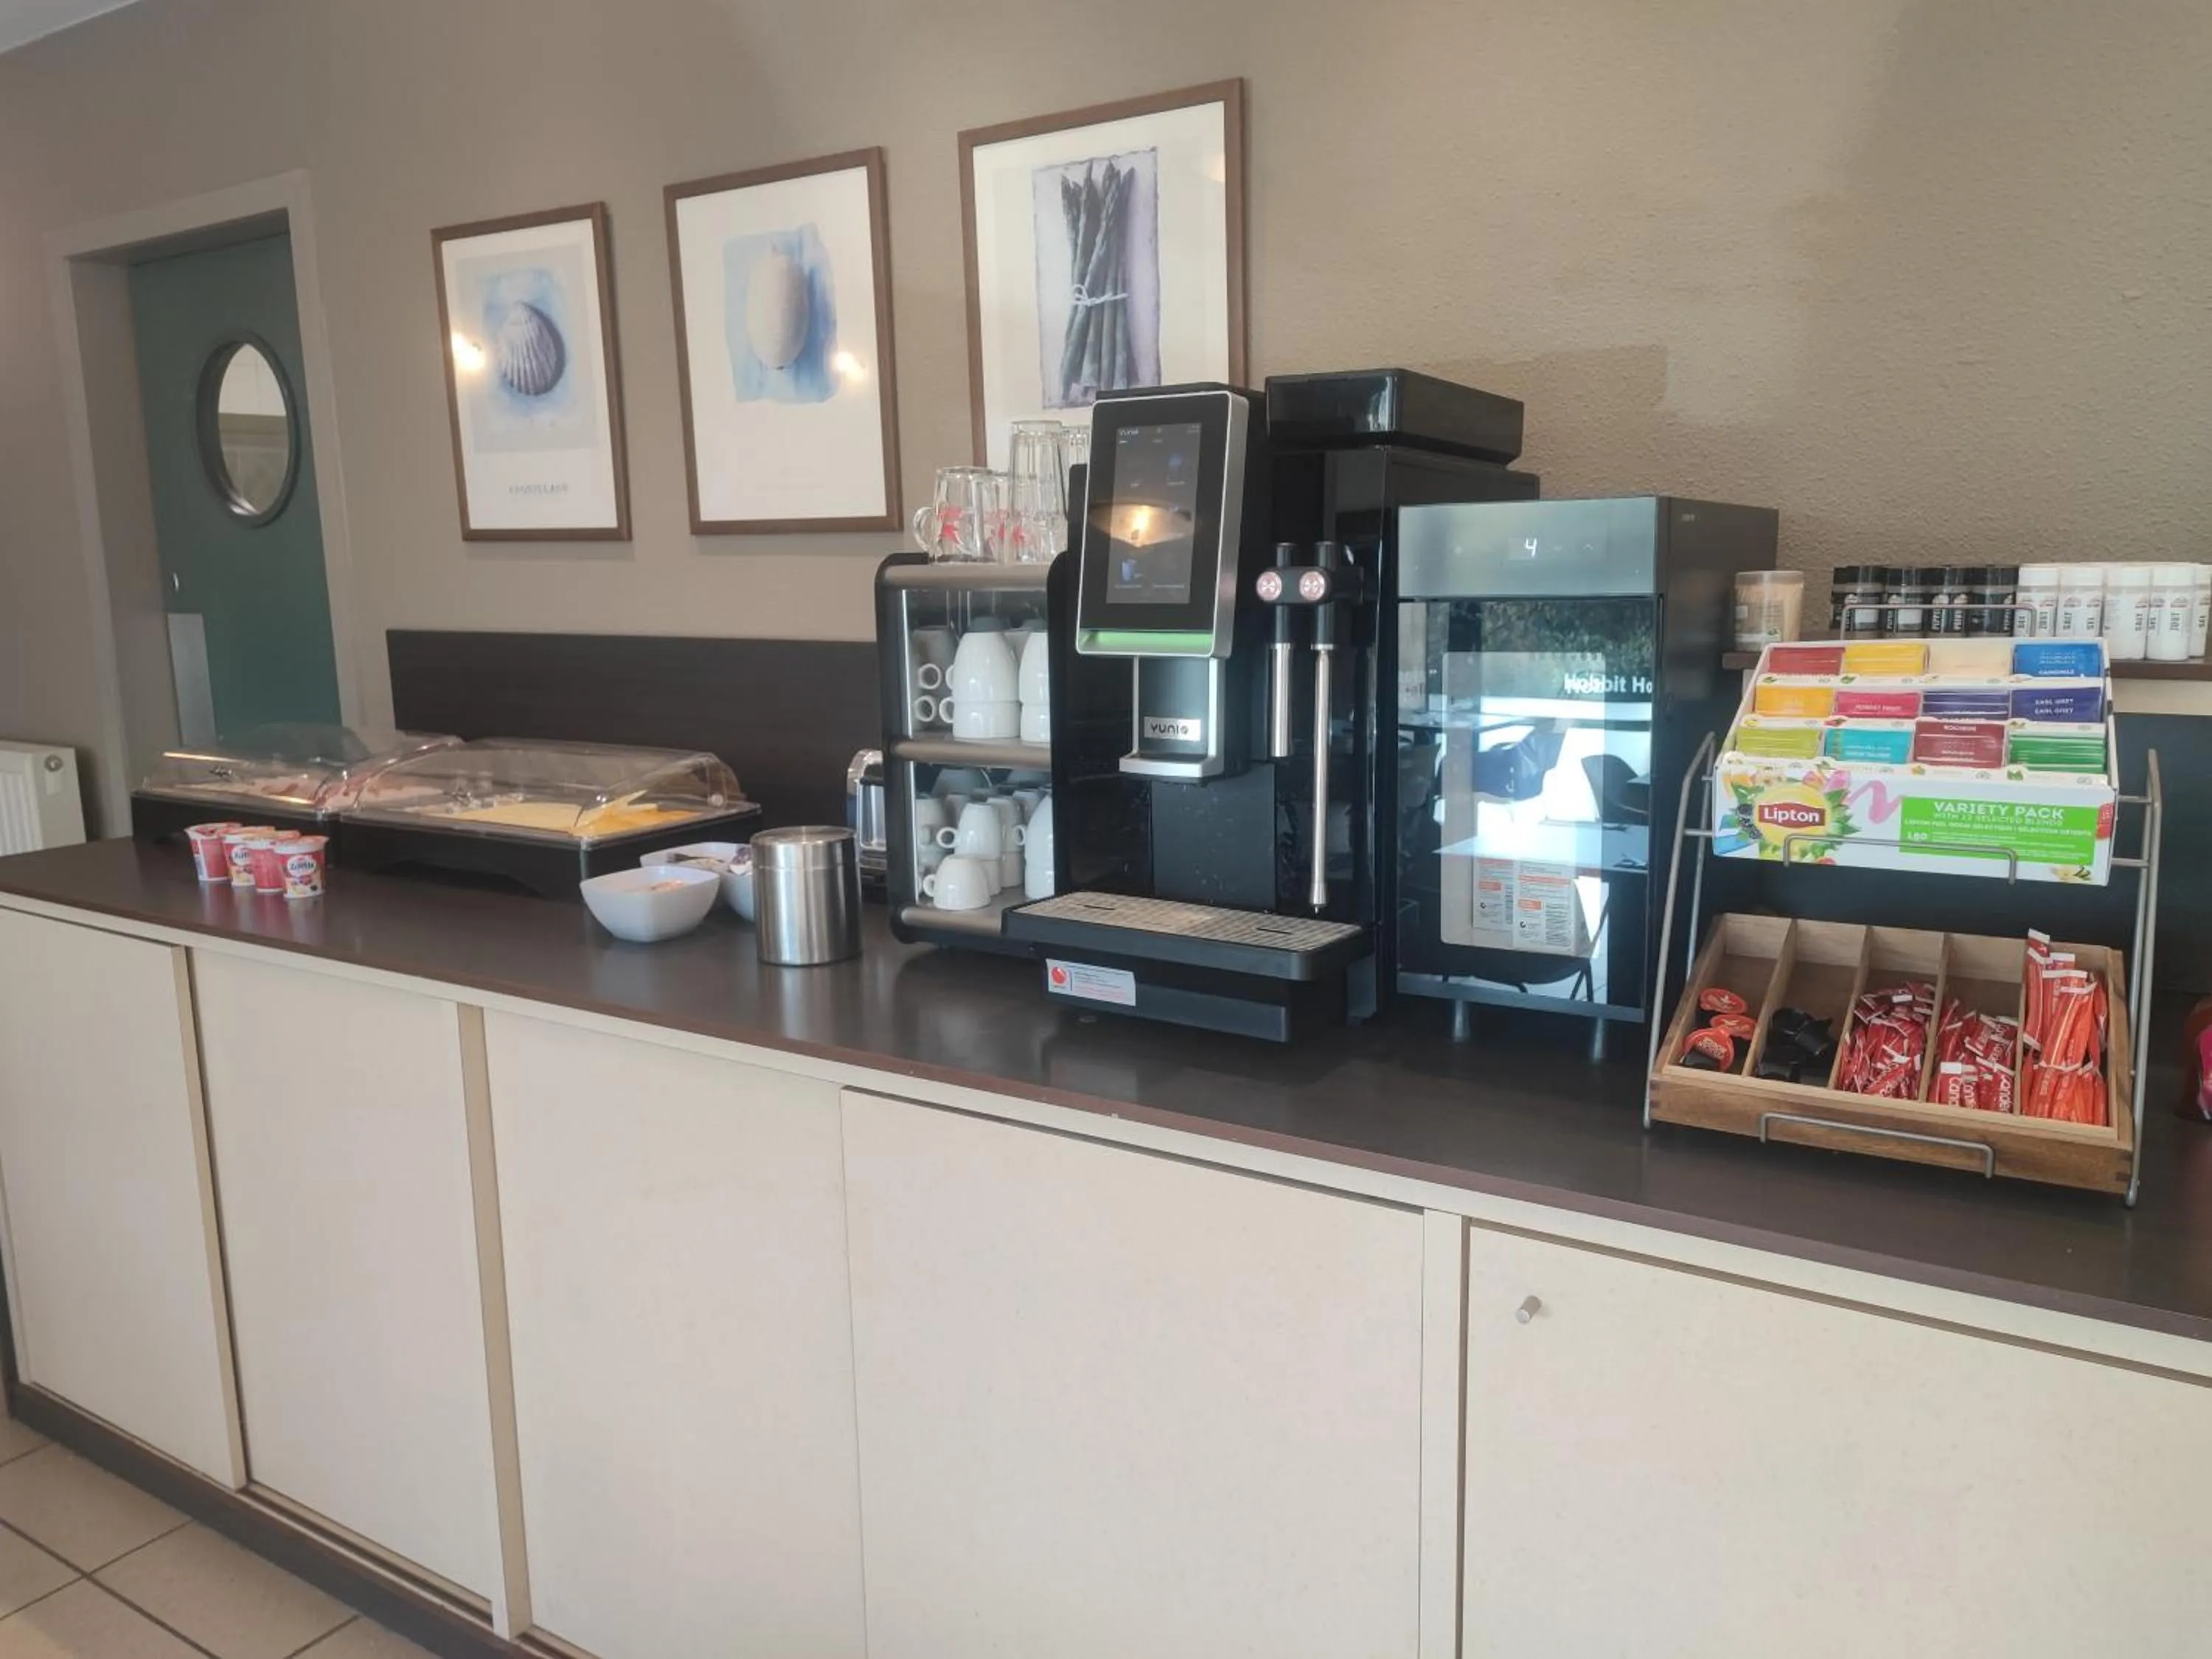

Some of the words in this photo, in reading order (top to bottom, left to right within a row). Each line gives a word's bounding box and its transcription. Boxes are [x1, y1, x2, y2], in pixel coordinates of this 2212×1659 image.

[1525, 537, 1537, 557] 4
[1764, 807, 1820, 823] Lipton
[1933, 801, 2010, 816] VARIETY
[2014, 807, 2065, 820] PACK
[1976, 815, 2023, 824] SELECTED
[2026, 817, 2064, 827] BLENDS
